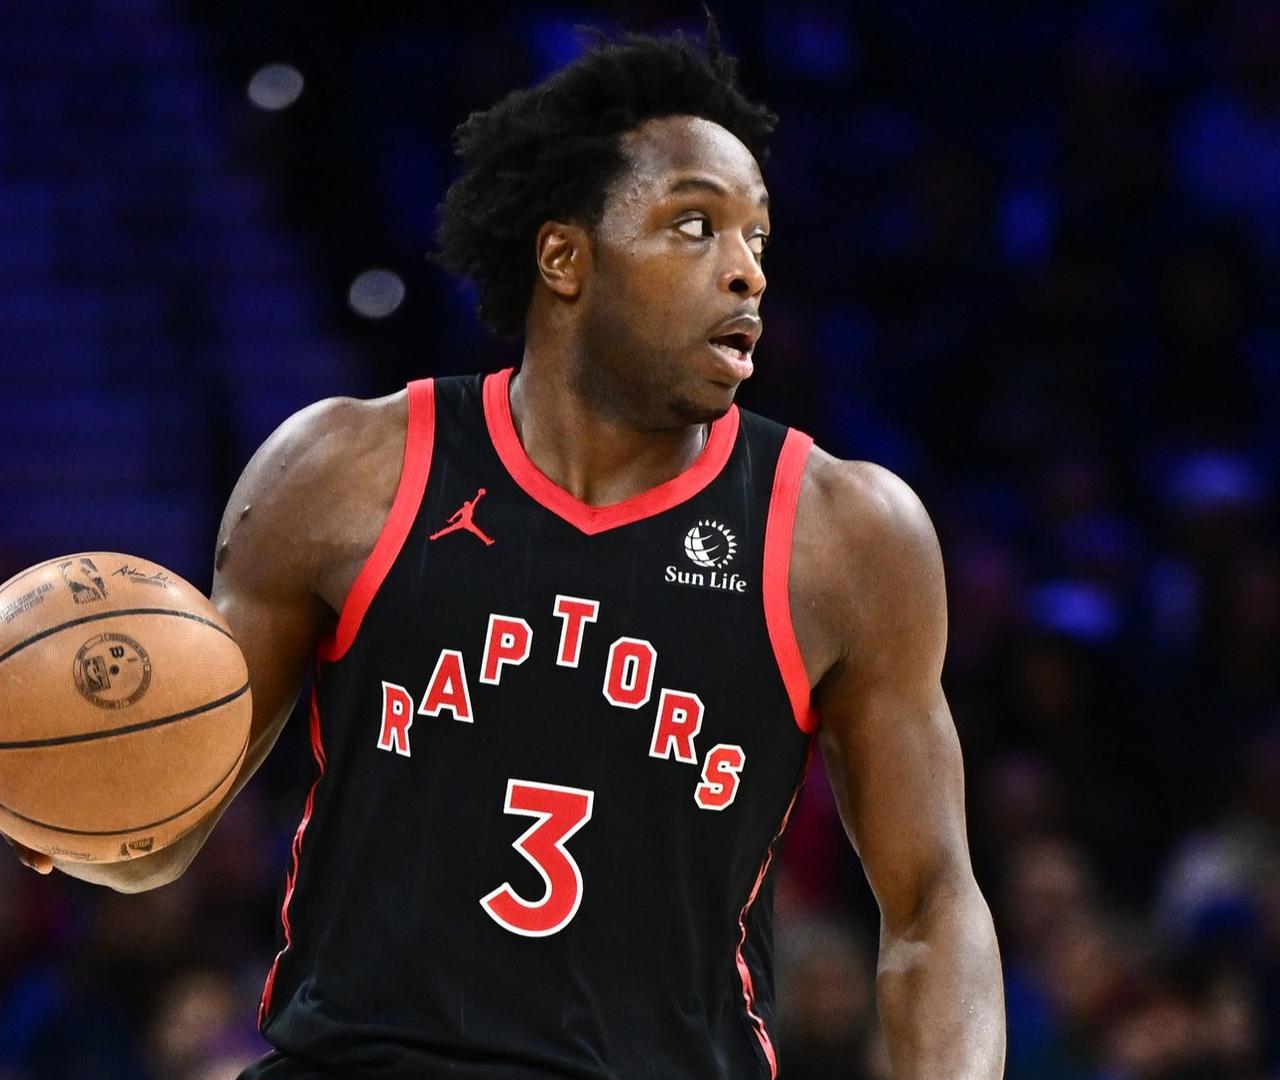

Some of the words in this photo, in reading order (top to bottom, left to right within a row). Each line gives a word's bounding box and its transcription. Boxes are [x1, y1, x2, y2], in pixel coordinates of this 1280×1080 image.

[664, 565, 705, 586] Sun
[710, 571, 748, 592] Life
[377, 594, 746, 811] RAPTORS
[479, 778, 595, 938] 3
